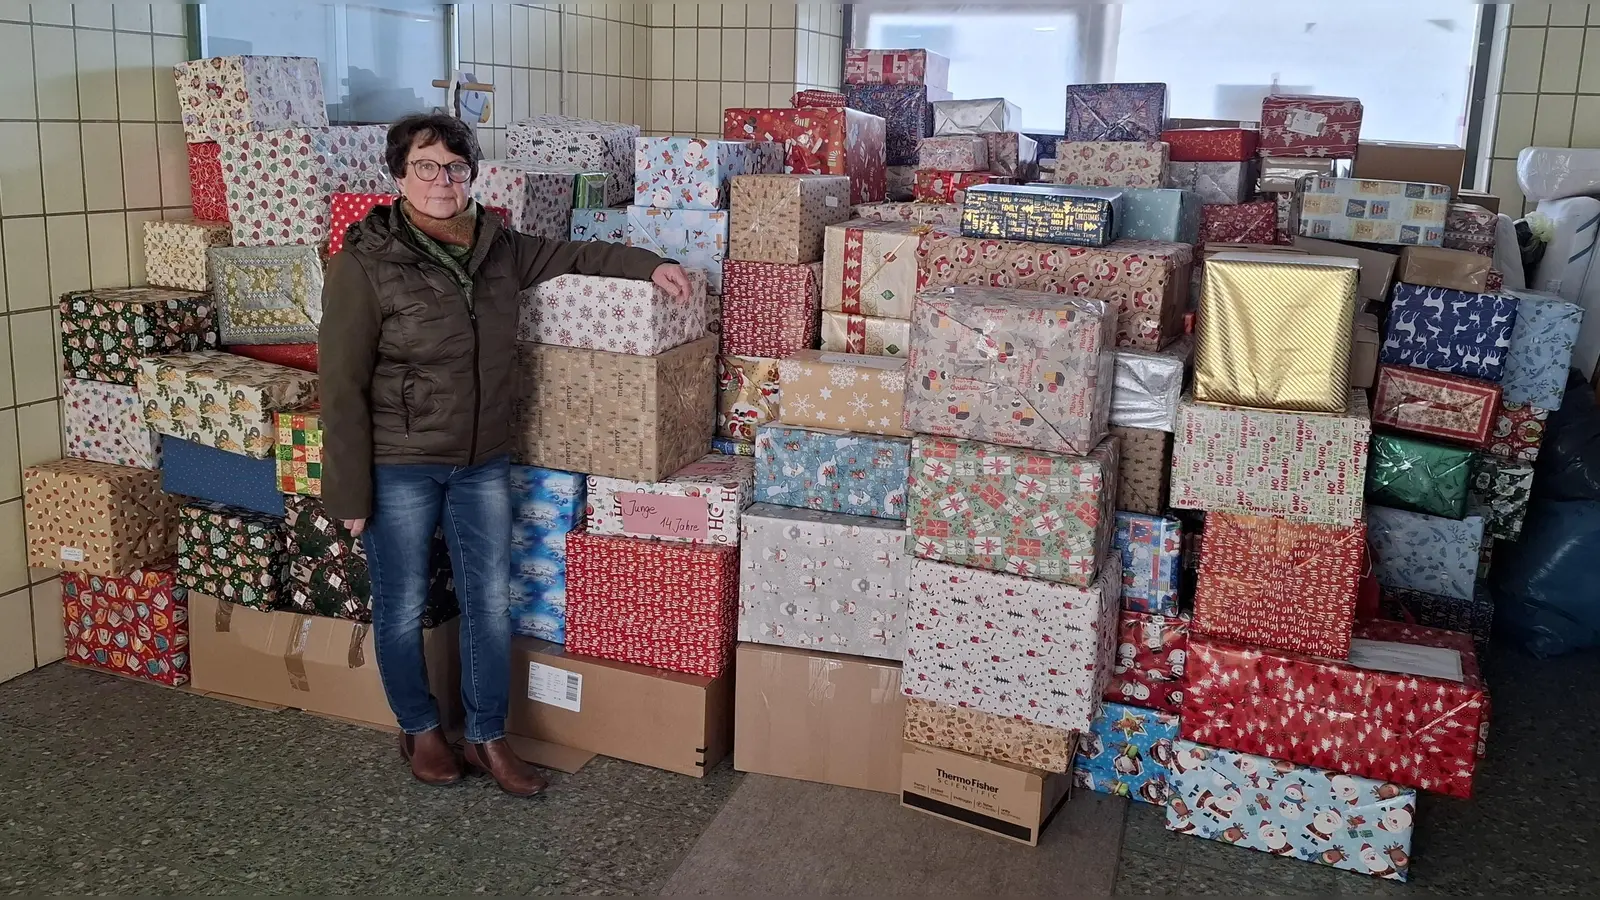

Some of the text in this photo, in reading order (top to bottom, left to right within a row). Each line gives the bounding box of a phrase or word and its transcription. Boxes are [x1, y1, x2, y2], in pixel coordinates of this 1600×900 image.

[1075, 213, 1100, 221] CHRISTMAS
[1079, 328, 1089, 349] Merry
[1019, 364, 1027, 385] Merry
[1025, 358, 1033, 389] Christmas
[616, 372, 625, 397] merry
[1070, 393, 1078, 415] Merry
[992, 437, 1022, 445] Christmas
[993, 432, 1015, 440] Merry
[624, 500, 658, 518] Junge
[660, 516, 700, 533] 14 Jahre
[938, 778, 998, 800] SCIENTIFIC
